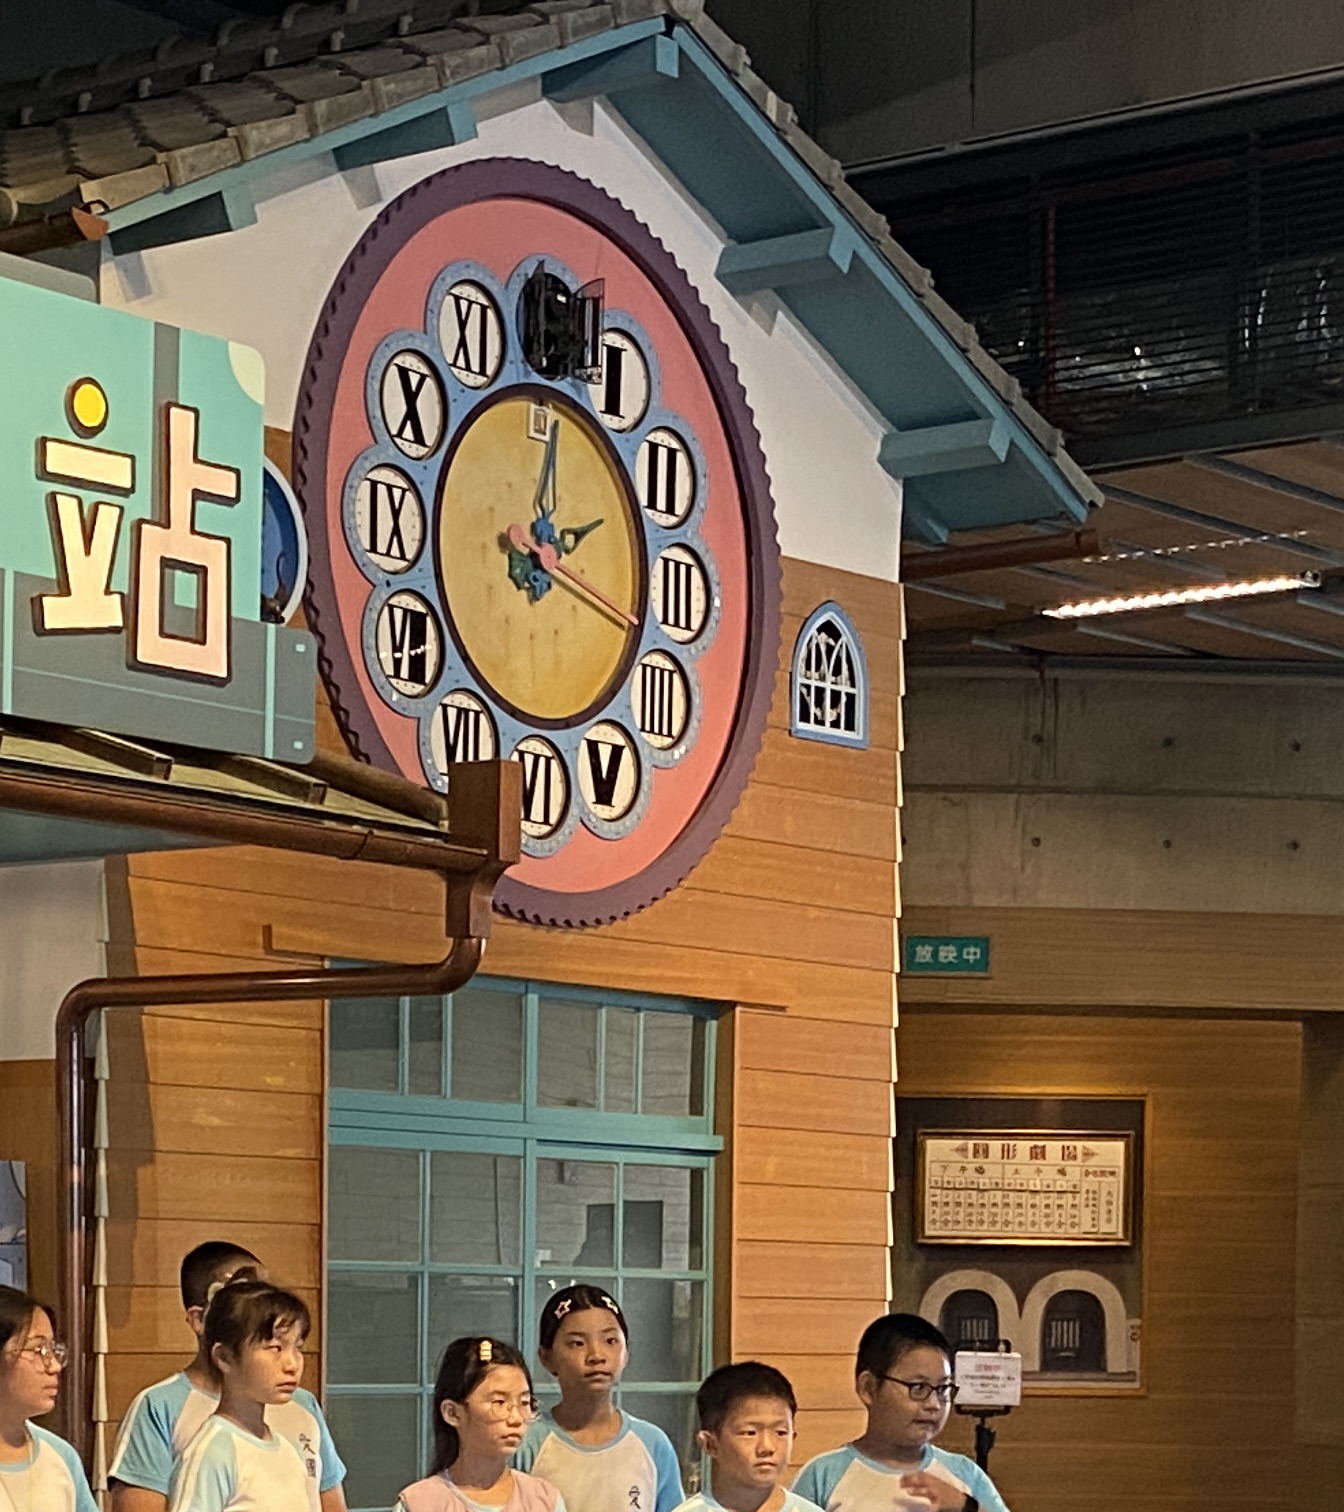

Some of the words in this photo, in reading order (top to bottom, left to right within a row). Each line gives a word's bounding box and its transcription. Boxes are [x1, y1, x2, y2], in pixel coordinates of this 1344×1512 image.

[448, 291, 492, 379] XI
[392, 362, 431, 448] X
[643, 439, 681, 517] II
[364, 477, 410, 563] IX
[660, 555, 696, 632] III
[640, 662, 677, 739] IIII
[584, 737, 626, 807] V
